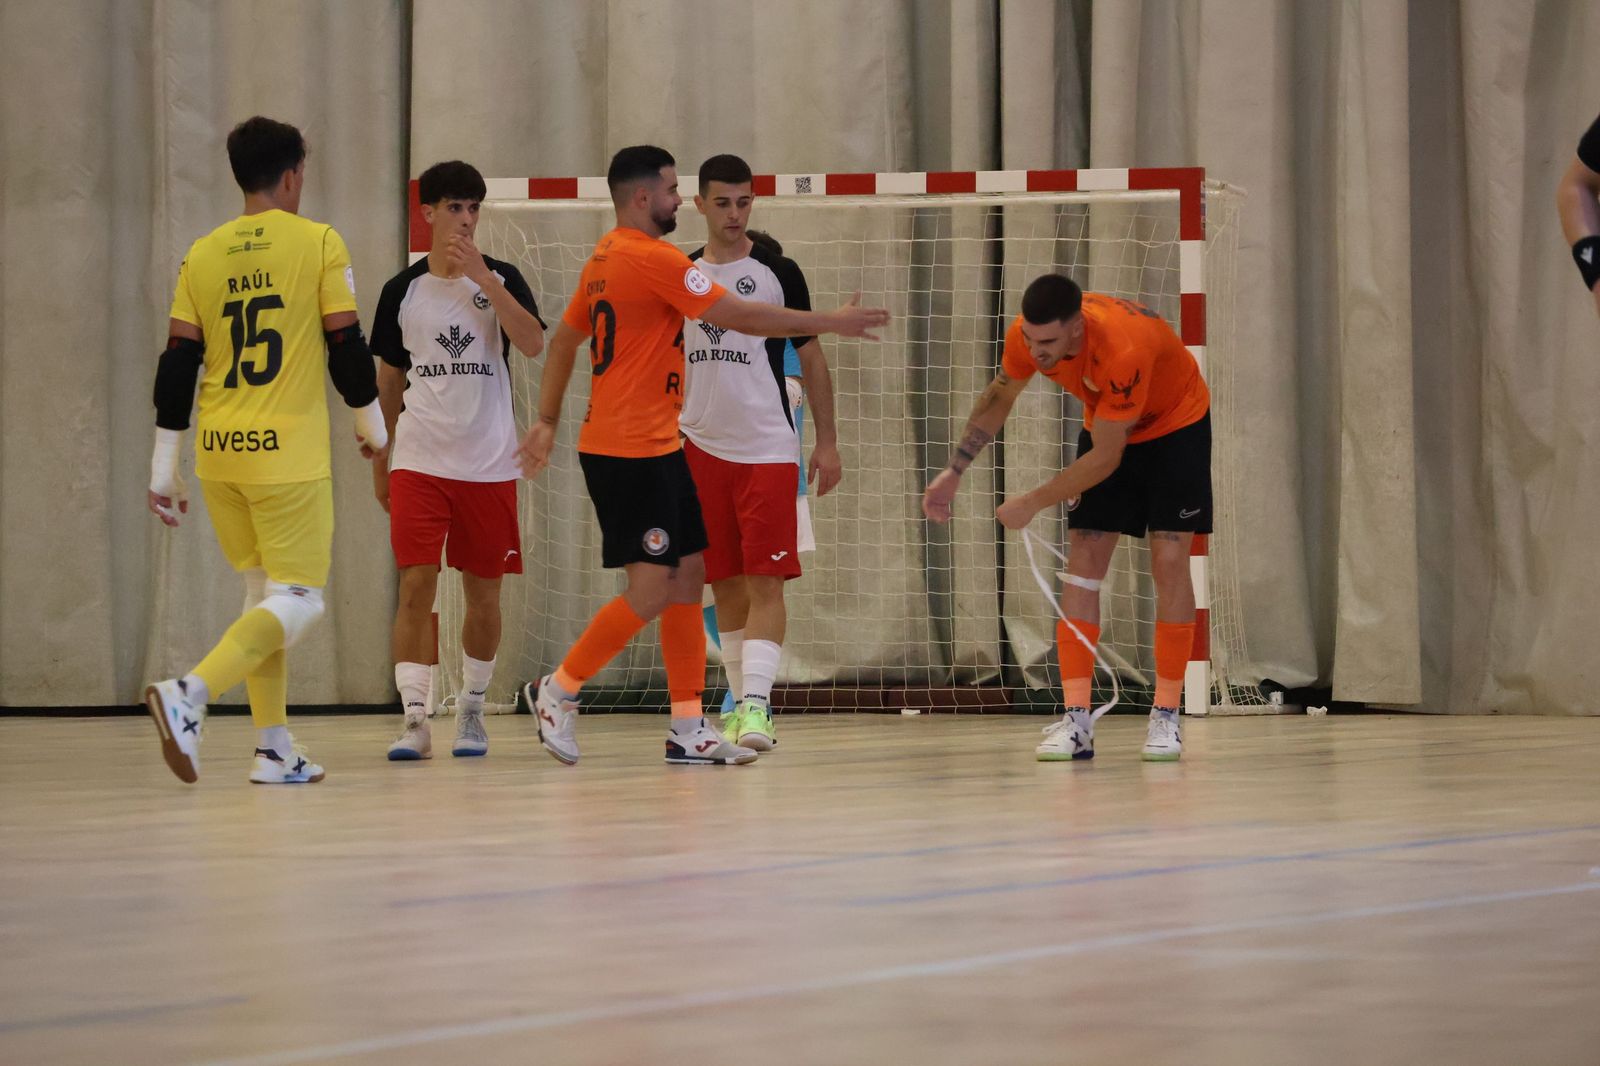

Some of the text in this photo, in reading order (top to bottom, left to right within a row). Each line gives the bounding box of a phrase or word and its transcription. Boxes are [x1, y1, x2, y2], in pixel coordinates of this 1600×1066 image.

[228, 269, 273, 294] RAÚL
[222, 294, 285, 389] 15
[688, 349, 708, 365] CJA
[416, 362, 494, 377] CAJA RURAL
[203, 429, 280, 452] uvesa
